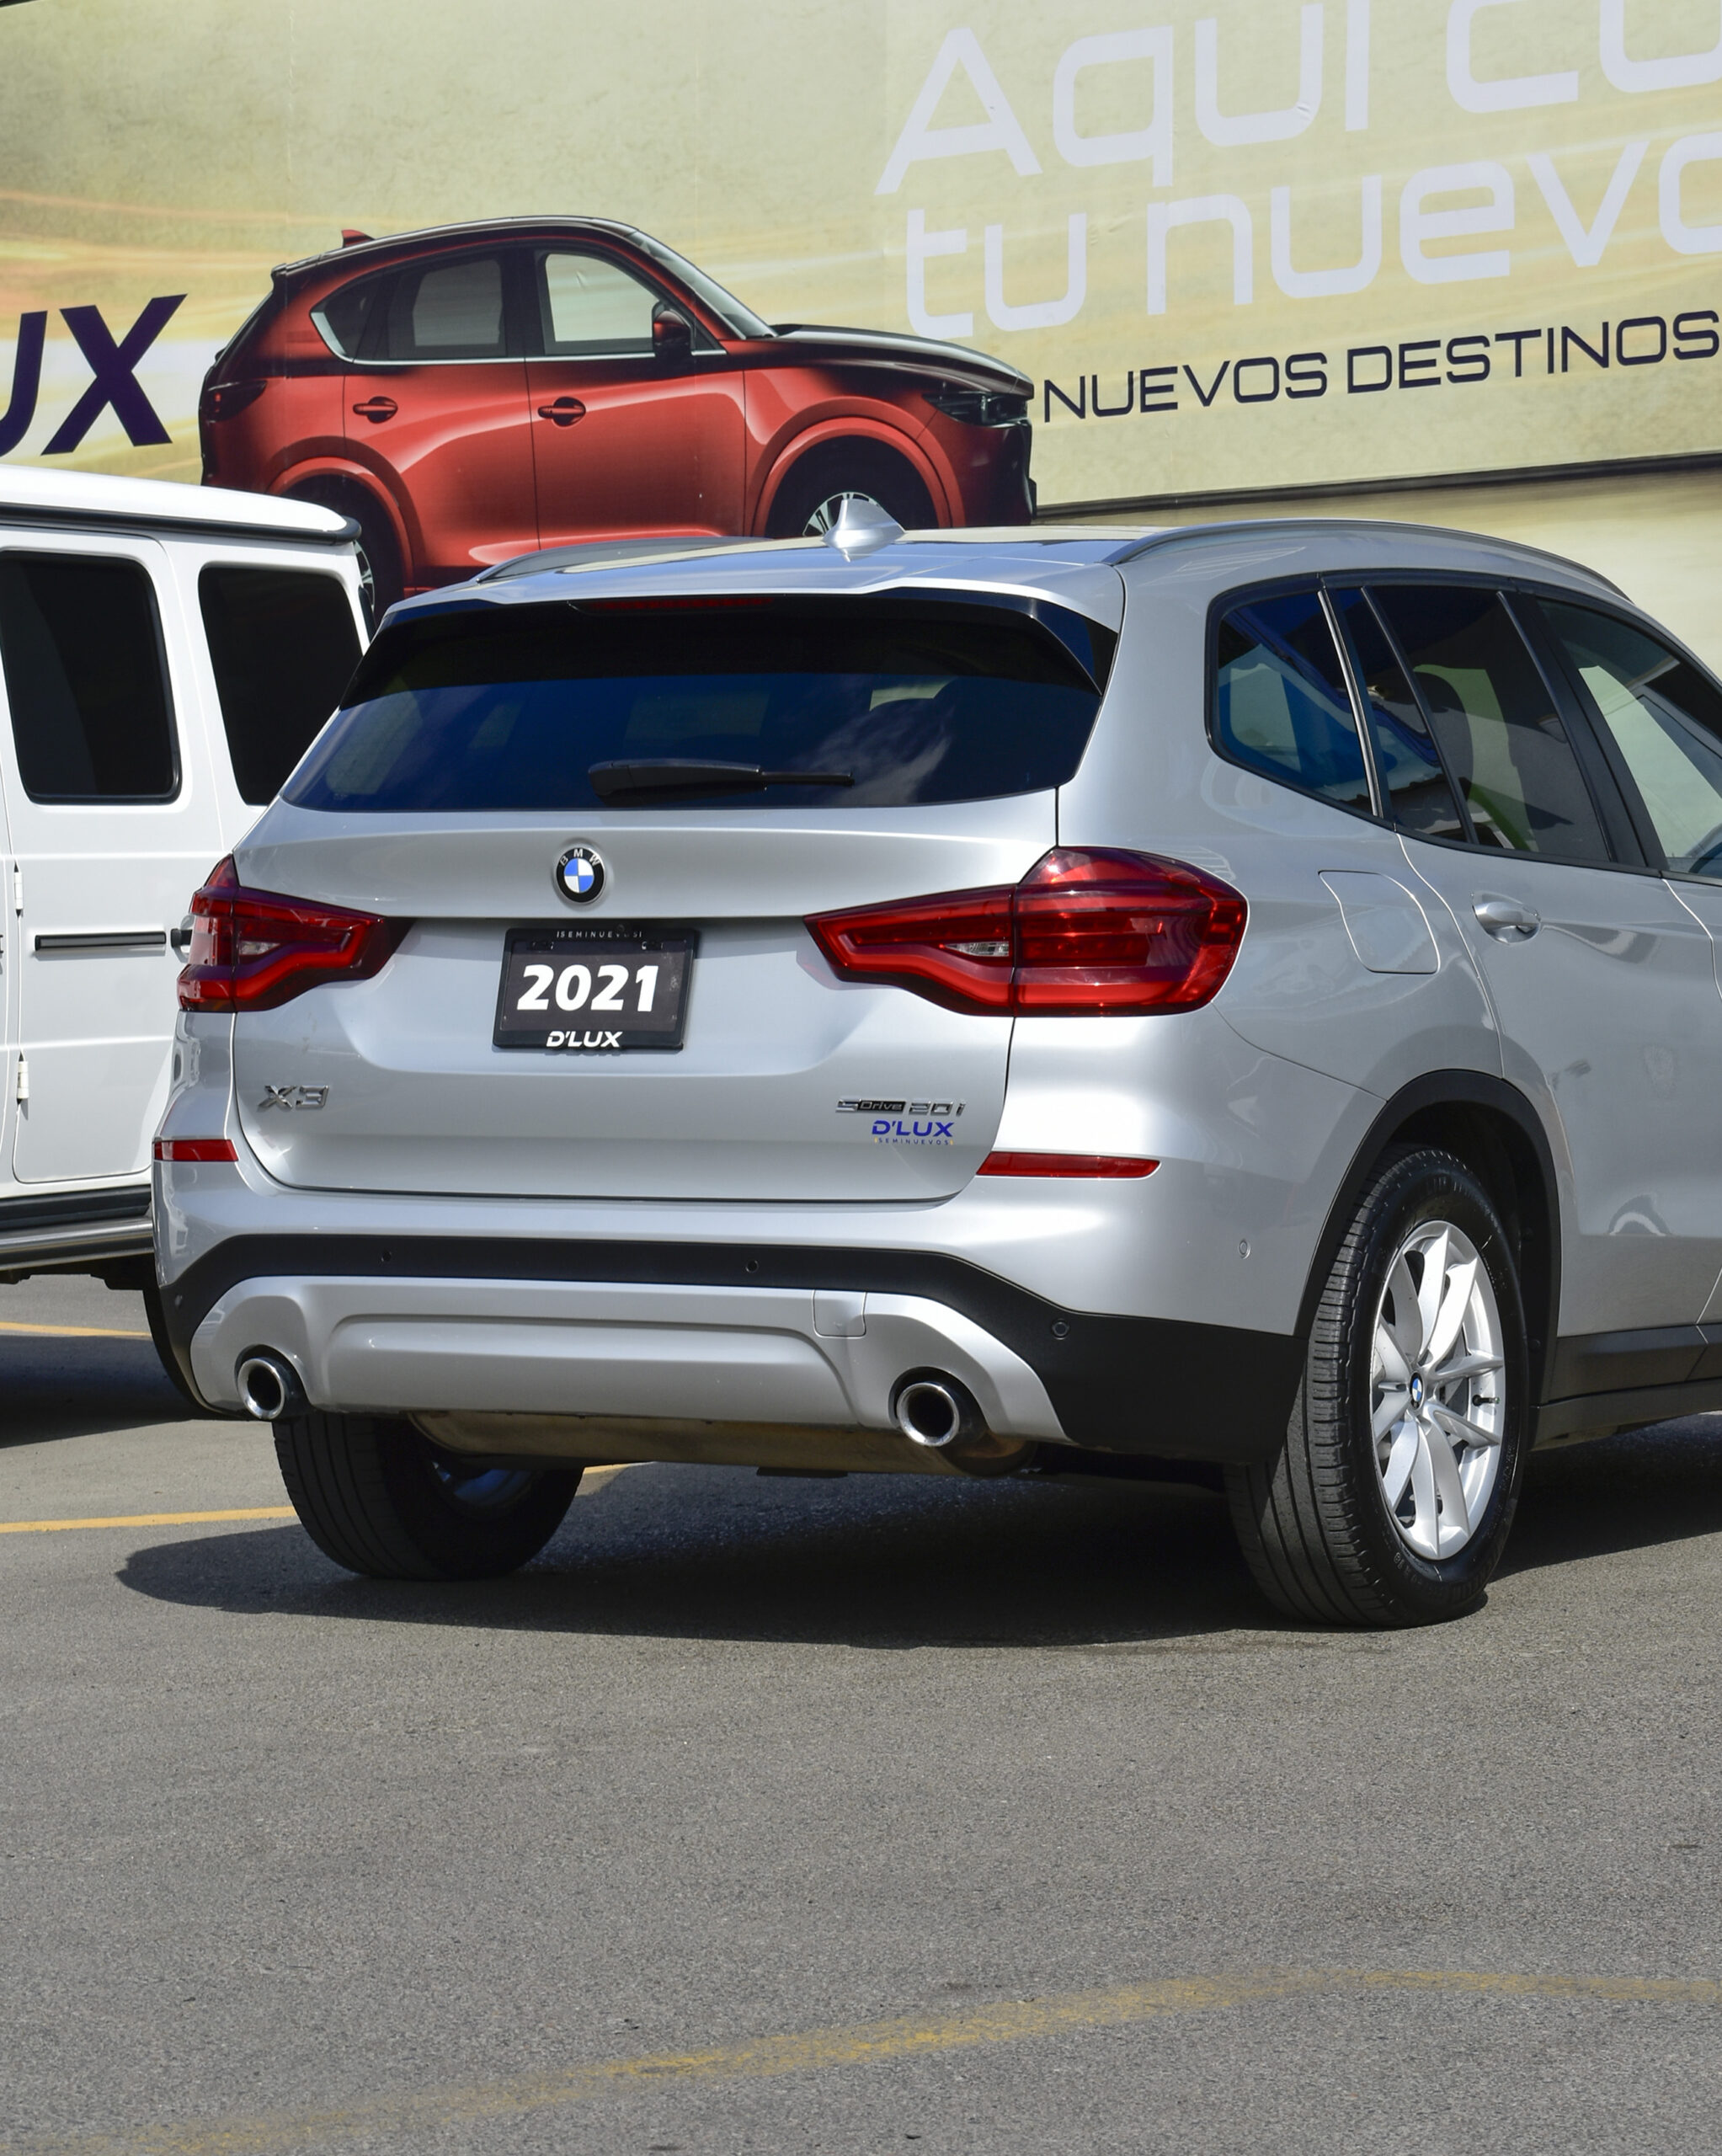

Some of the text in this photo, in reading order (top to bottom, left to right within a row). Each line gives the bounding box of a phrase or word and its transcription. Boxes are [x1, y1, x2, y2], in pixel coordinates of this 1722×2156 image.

[907, 209, 1086, 338] tu
[1044, 310, 1719, 423] NUEVOS DESTINOS
[559, 848, 600, 867] BMW
[517, 964, 658, 1011] 2021
[546, 1030, 623, 1048] D'LUX
[258, 1085, 329, 1110] X3
[872, 1120, 955, 1137] D'LUX
[878, 1137, 949, 1145] SEMINUEVOS
